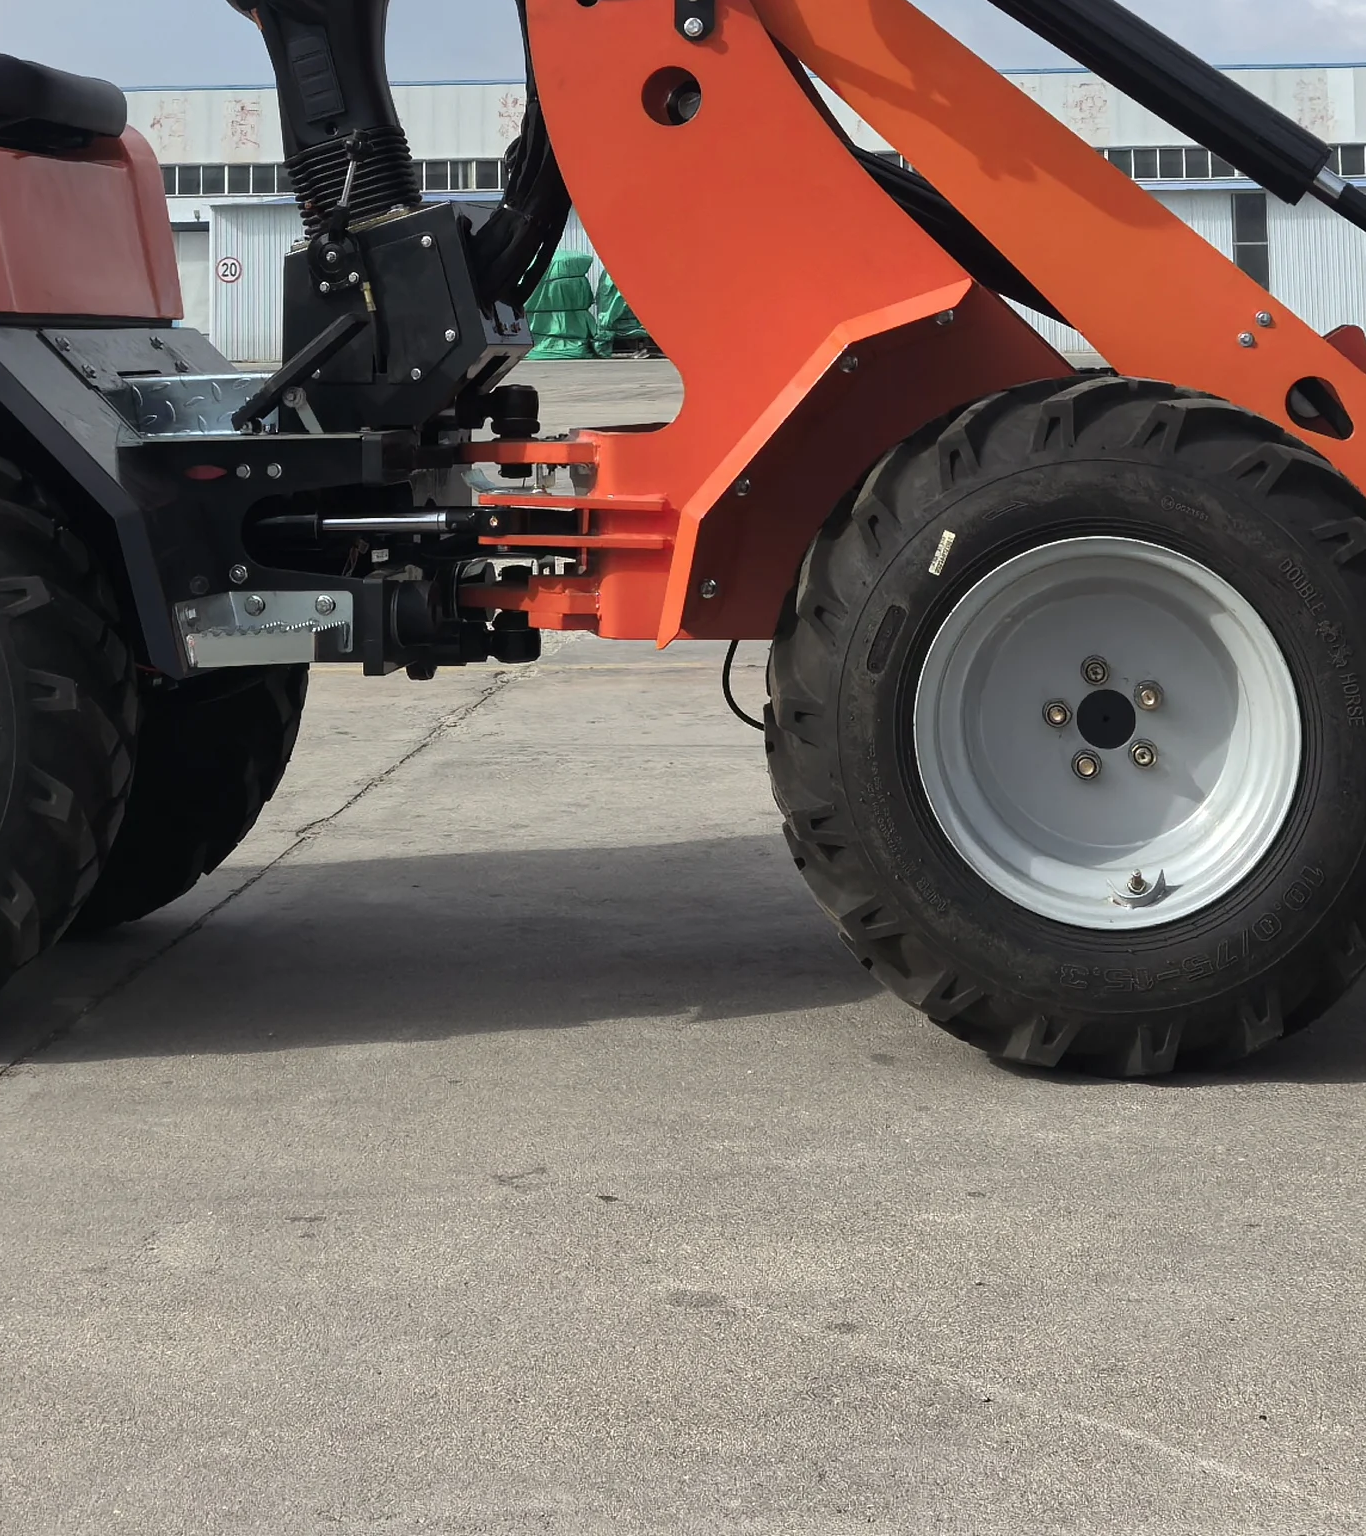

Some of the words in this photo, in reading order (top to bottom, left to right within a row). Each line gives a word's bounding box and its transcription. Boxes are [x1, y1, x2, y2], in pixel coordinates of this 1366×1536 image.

[221, 262, 237, 277] 20
[1278, 557, 1327, 617] DOUBLE
[1339, 672, 1365, 727] HORSE
[1058, 862, 1325, 994] 10.0/75-15.3
